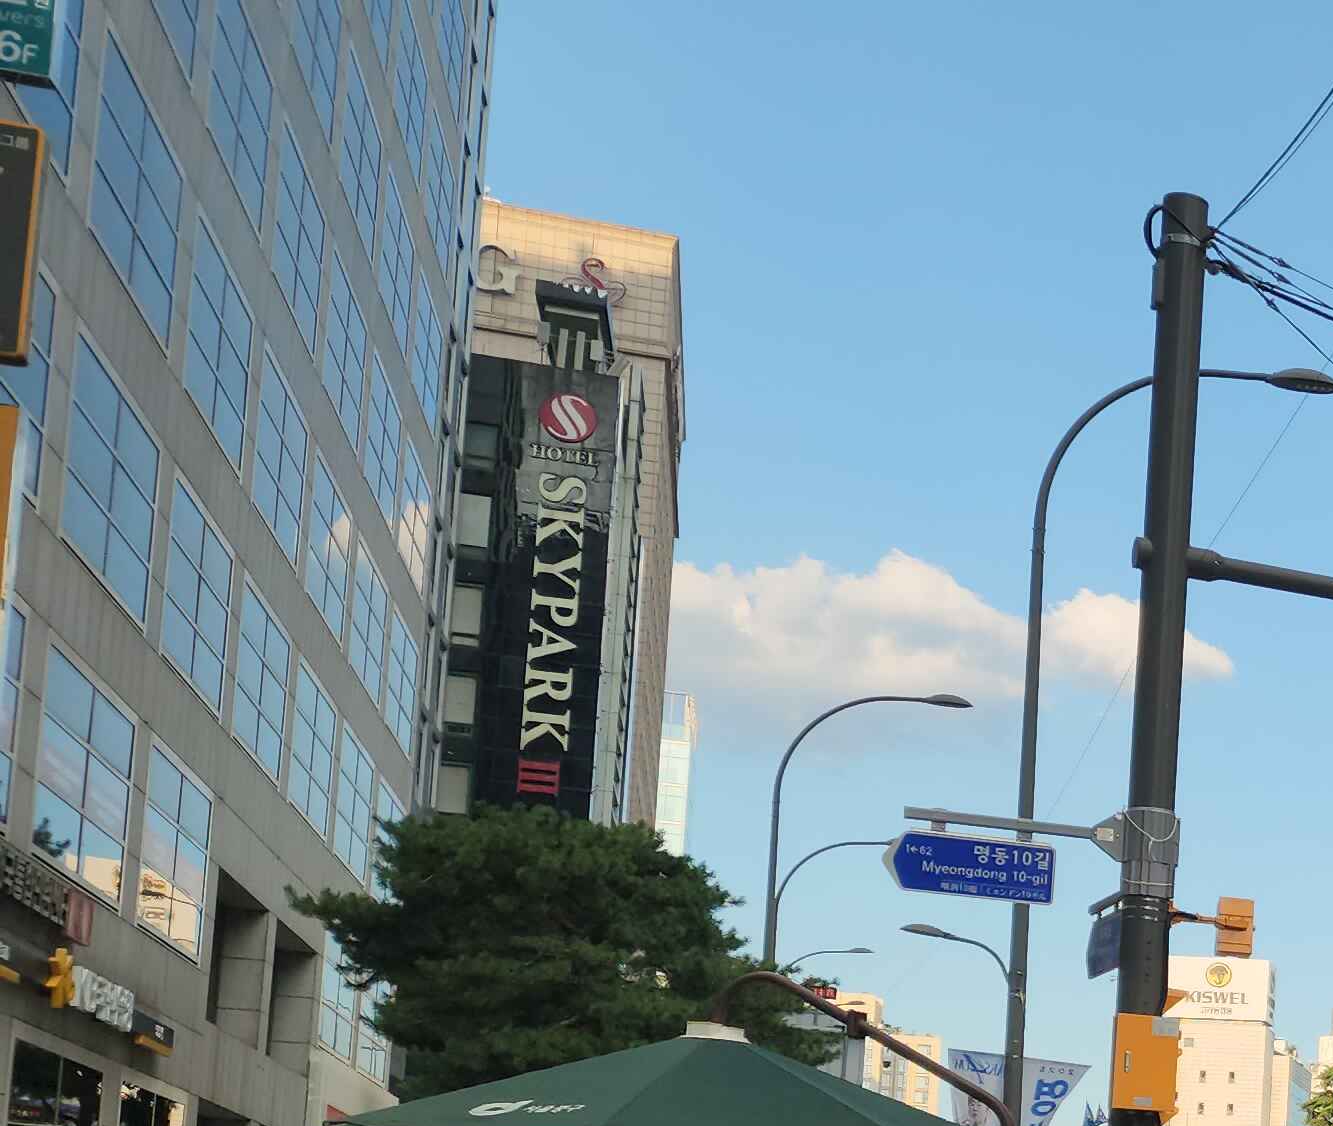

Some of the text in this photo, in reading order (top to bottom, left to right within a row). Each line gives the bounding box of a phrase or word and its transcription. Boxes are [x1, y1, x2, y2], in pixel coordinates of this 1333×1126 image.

[530, 443, 599, 466] HOTEL
[519, 472, 588, 752] SKYPARK
[973, 845, 1049, 871] 명동10길
[921, 860, 1048, 887] Myeongdong 10-gil
